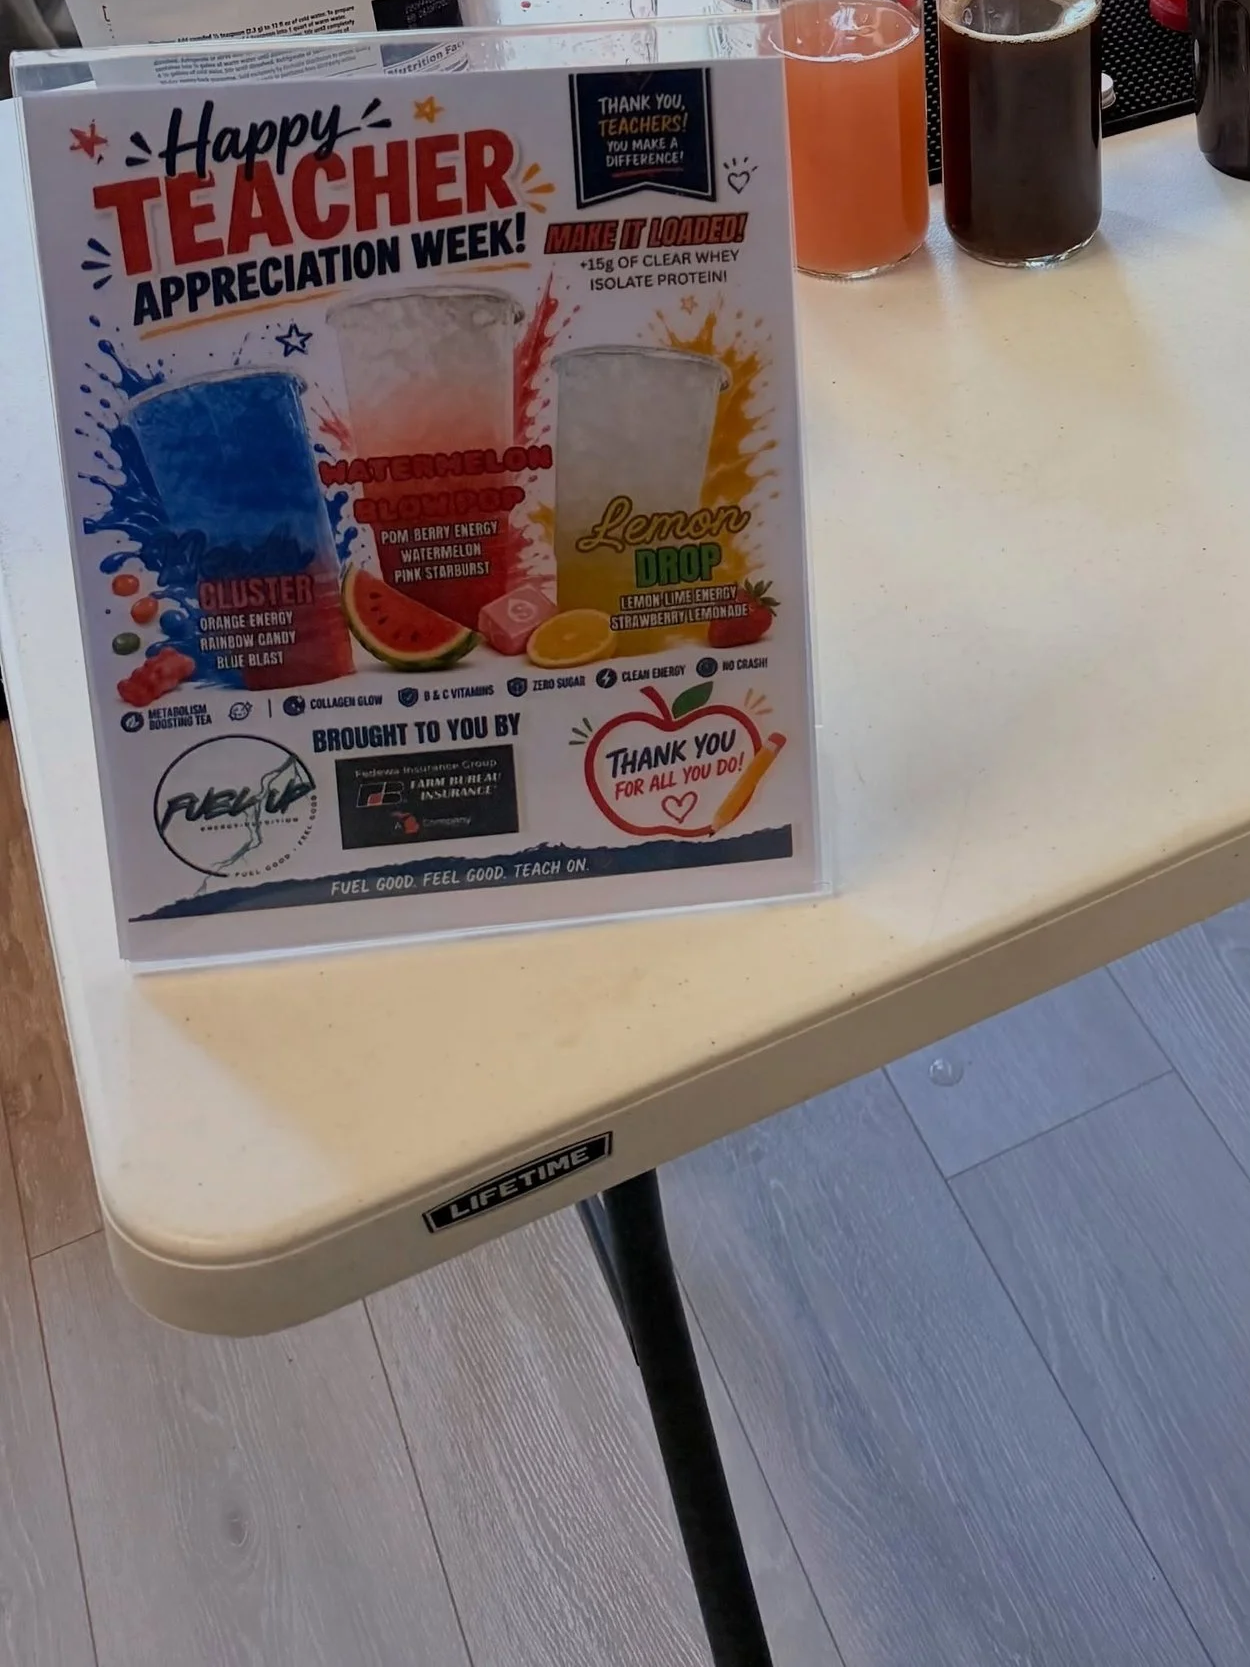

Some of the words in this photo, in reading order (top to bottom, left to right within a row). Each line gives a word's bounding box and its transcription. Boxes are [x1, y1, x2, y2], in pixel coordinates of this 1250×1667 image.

[598, 94, 650, 116] THANK
[654, 93, 686, 112] YOU,
[598, 112, 689, 138] TEACHERS!
[160, 100, 361, 181] Happy
[606, 139, 629, 153] YOU
[632, 137, 666, 151] MAKE
[670, 136, 679, 150] A
[605, 150, 685, 169] DIFFERENCE!
[93, 128, 518, 277] TEACHER
[543, 220, 618, 254] MAKE
[619, 217, 648, 250] IT
[646, 212, 749, 249] LOADED!
[133, 236, 401, 327] APPRECIATION
[411, 211, 527, 270] WEEK!
[580, 258, 614, 274] +15g
[617, 254, 640, 270] OF
[642, 251, 691, 268] CLEAR
[695, 248, 740, 264] WHEY
[590, 274, 654, 292] ISOLATE
[656, 270, 728, 287] PROTEIN!
[318, 444, 554, 488] WATERMELON
[353, 491, 452, 524] BLOW
[452, 485, 527, 516] POP
[381, 528, 410, 545] POM
[413, 524, 451, 542] BERRY
[455, 520, 499, 539] ENERGY
[575, 495, 752, 553] Lemon
[401, 542, 482, 563] WATERMELON
[634, 542, 722, 588] DROP
[394, 568, 422, 584] PINK
[424, 561, 490, 580] STARBURST
[199, 574, 315, 611] CLUSTER
[620, 593, 661, 611] LEMON
[663, 589, 693, 607] LIME
[694, 584, 738, 605] ENERGY
[200, 614, 246, 632] ORANGE
[249, 610, 294, 628] ENERGY
[611, 610, 687, 631] STRAWBERRY
[687, 603, 749, 623] LEMONADE
[200, 634, 255, 652] RAINBOW
[258, 630, 297, 647] CANDY
[217, 654, 245, 670] BLUE
[248, 650, 284, 668] BLAST
[722, 659, 736, 672] NO
[736, 657, 768, 670] CRASH!
[532, 678, 555, 692] ZERO
[556, 675, 586, 689] SUGAR
[621, 668, 650, 683] CLEAN
[651, 664, 686, 680] ENERGY
[310, 696, 355, 711] COLLAGEN
[357, 694, 384, 708] GLOW
[423, 690, 431, 703] B
[432, 689, 440, 701] &
[442, 689, 449, 700] C
[450, 684, 495, 700] VITAMINS
[148, 704, 208, 720] METABOLISM
[149, 717, 194, 732] BOOSTING
[196, 713, 213, 728] TEA
[312, 723, 408, 754] BROUGHT
[414, 720, 441, 743] TO
[448, 716, 489, 741] YOU
[495, 712, 521, 738] BY
[403, 762, 460, 775] Insurance
[461, 757, 498, 770] Group
[605, 739, 687, 779] THANK
[693, 729, 737, 760] YOU
[409, 777, 447, 791] FARM
[449, 772, 502, 787] BUREAU
[614, 777, 644, 801] FOR
[649, 771, 677, 793] ALL
[682, 762, 712, 785] YOU
[716, 751, 746, 777] DO!
[161, 786, 261, 834] FUEL
[265, 778, 317, 815] UP
[331, 879, 370, 897] FUEL
[376, 874, 418, 893] GOOD.
[423, 870, 461, 888] FEEL
[466, 865, 508, 884] GOOD.
[514, 859, 561, 879] TEACH
[566, 857, 590, 874] ON.
[450, 1145, 590, 1221] LIFETIME
